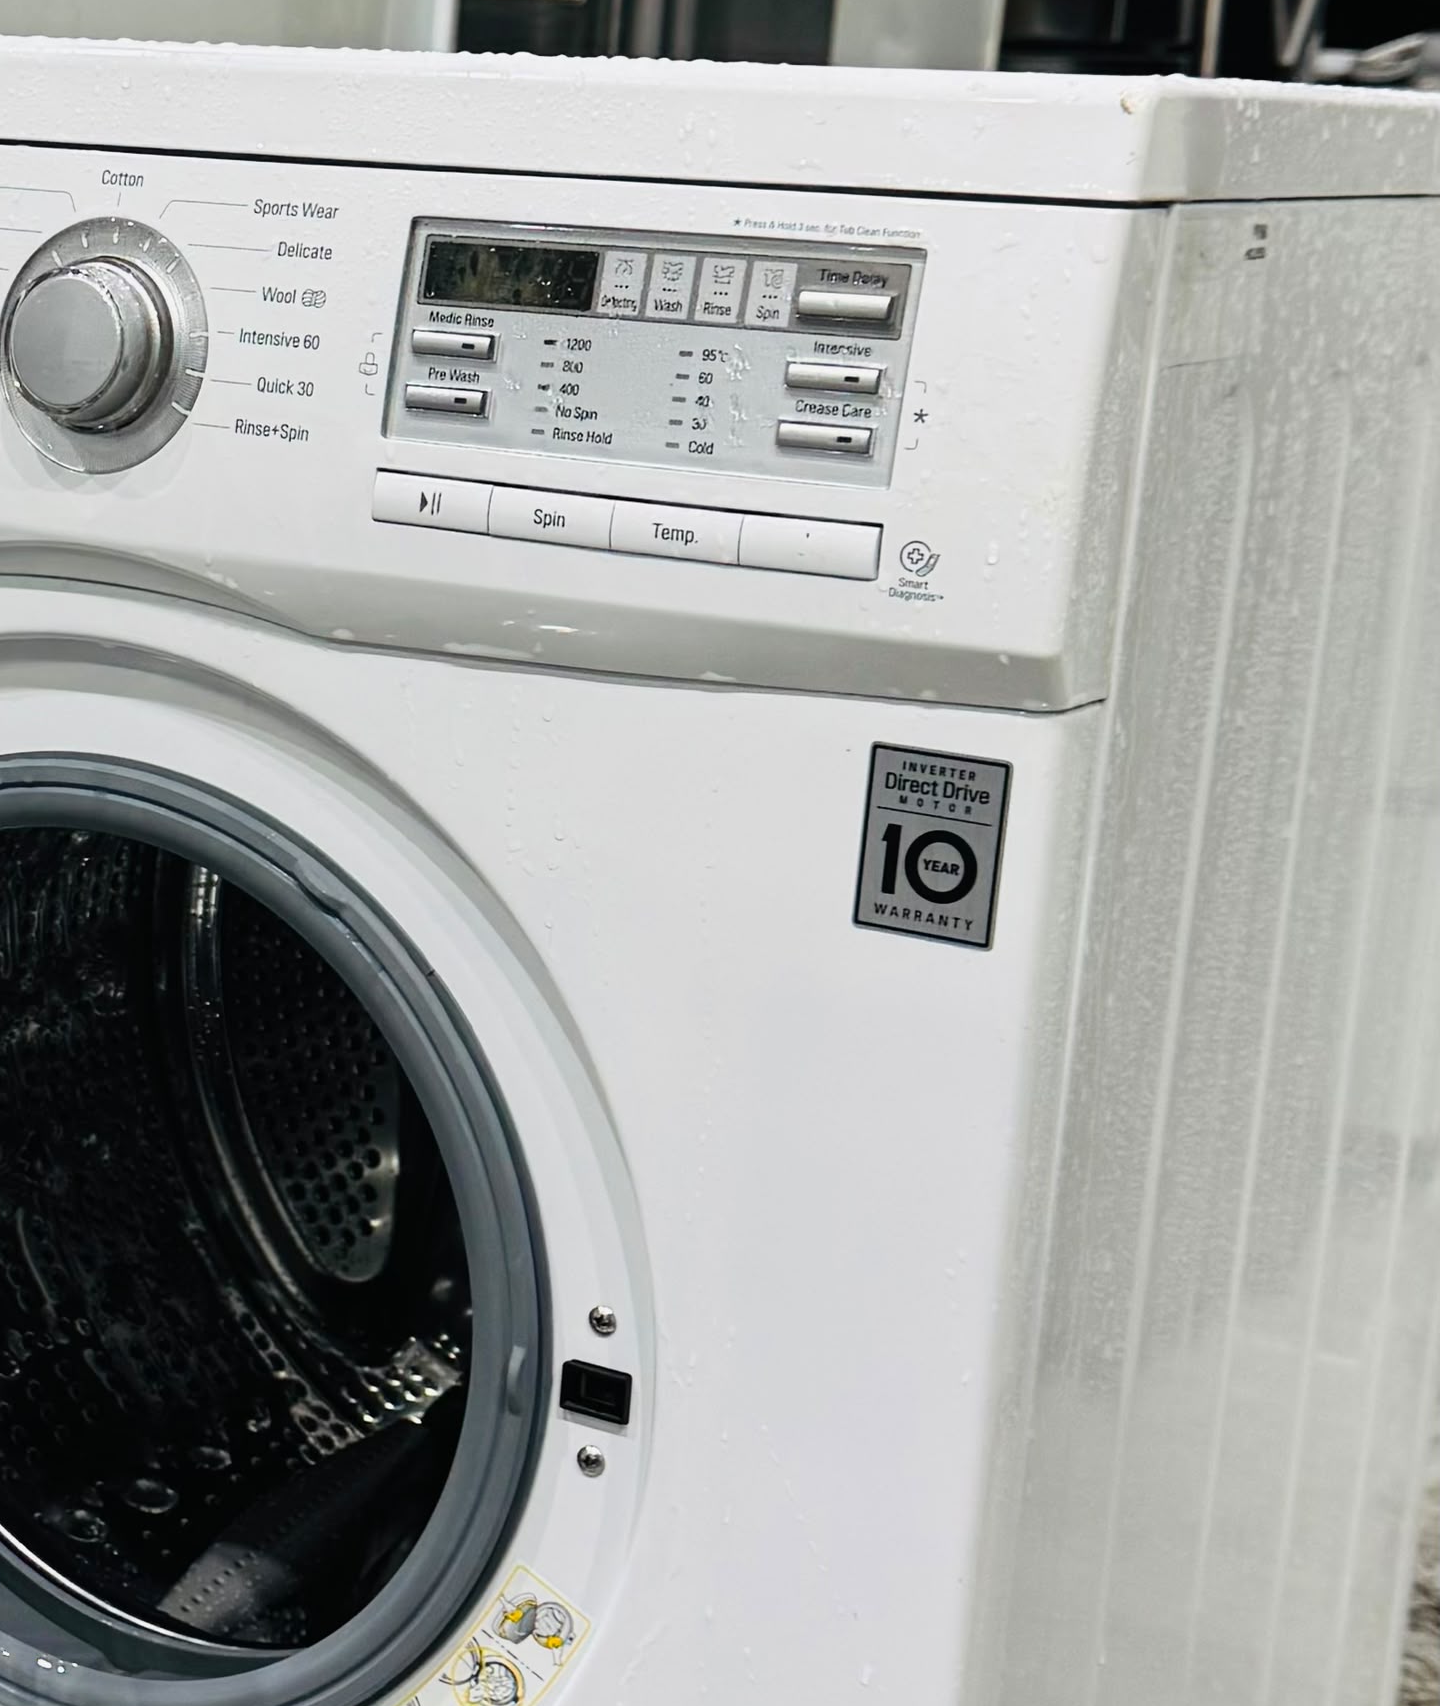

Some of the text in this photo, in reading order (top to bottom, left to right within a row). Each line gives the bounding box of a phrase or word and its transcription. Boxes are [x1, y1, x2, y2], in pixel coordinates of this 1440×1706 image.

[102, 169, 144, 187] Cotton
[253, 198, 339, 219] Sports Wear
[278, 241, 332, 260] Delicate
[819, 268, 849, 284] Time
[262, 286, 296, 304] Wool
[654, 299, 683, 313] Wash
[703, 301, 732, 316] Rinse
[756, 306, 780, 321] Spin
[429, 310, 495, 328] Medic Rinse
[239, 328, 320, 350] Intensive 60
[566, 338, 592, 351] 1200
[428, 366, 480, 384] Pre Wash
[698, 372, 713, 385] 60
[257, 376, 314, 397] Quick 30
[559, 382, 580, 396] 400
[555, 405, 598, 421] No Spin
[795, 399, 872, 419] Crease Care
[235, 418, 309, 442] Rinse+Spin
[552, 427, 613, 445] Rinse Hold
[688, 441, 714, 455] Cold
[533, 509, 565, 529] Spin
[652, 522, 699, 545] Temp.
[898, 577, 929, 591] Smart
[902, 760, 976, 781] INVERTER
[885, 771, 991, 805] Direct Drive
[899, 794, 972, 815] MOTOR
[881, 823, 978, 905] 10
[923, 858, 960, 876] YEAR
[874, 902, 974, 931] WARRANTY
